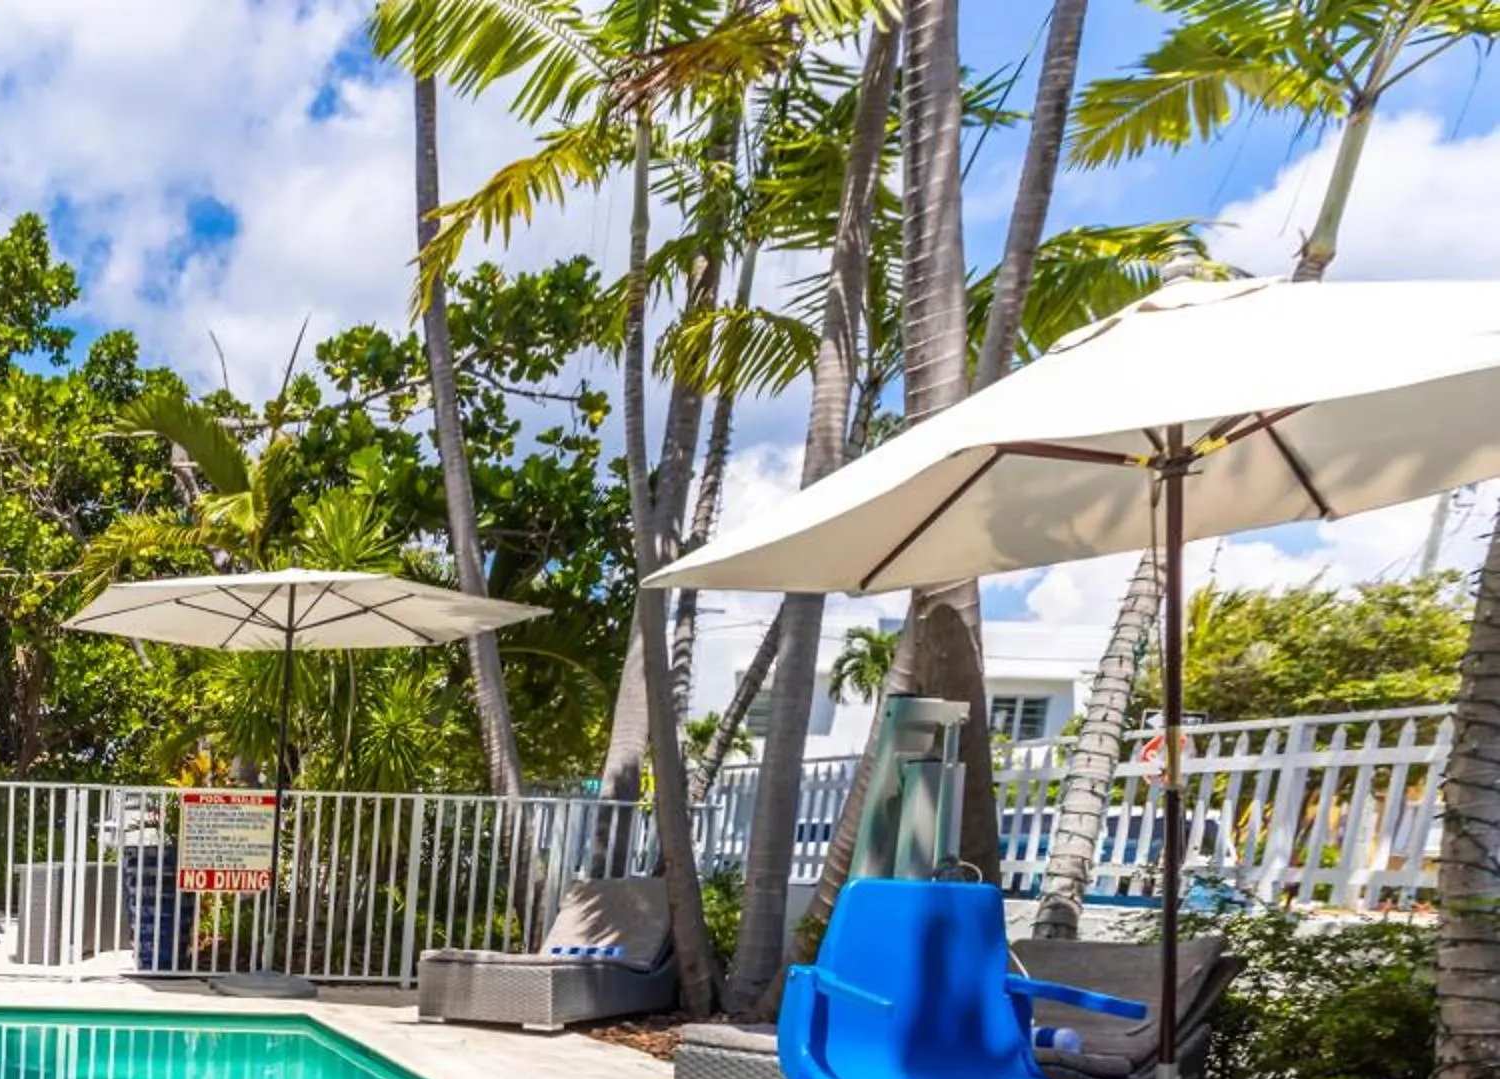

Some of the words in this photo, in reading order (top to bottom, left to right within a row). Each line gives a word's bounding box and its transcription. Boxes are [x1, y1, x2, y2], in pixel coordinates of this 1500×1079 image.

[199, 795, 224, 803] POOL
[231, 796, 263, 804] RULES
[184, 871, 207, 889] NO
[213, 871, 269, 890] DIVING
